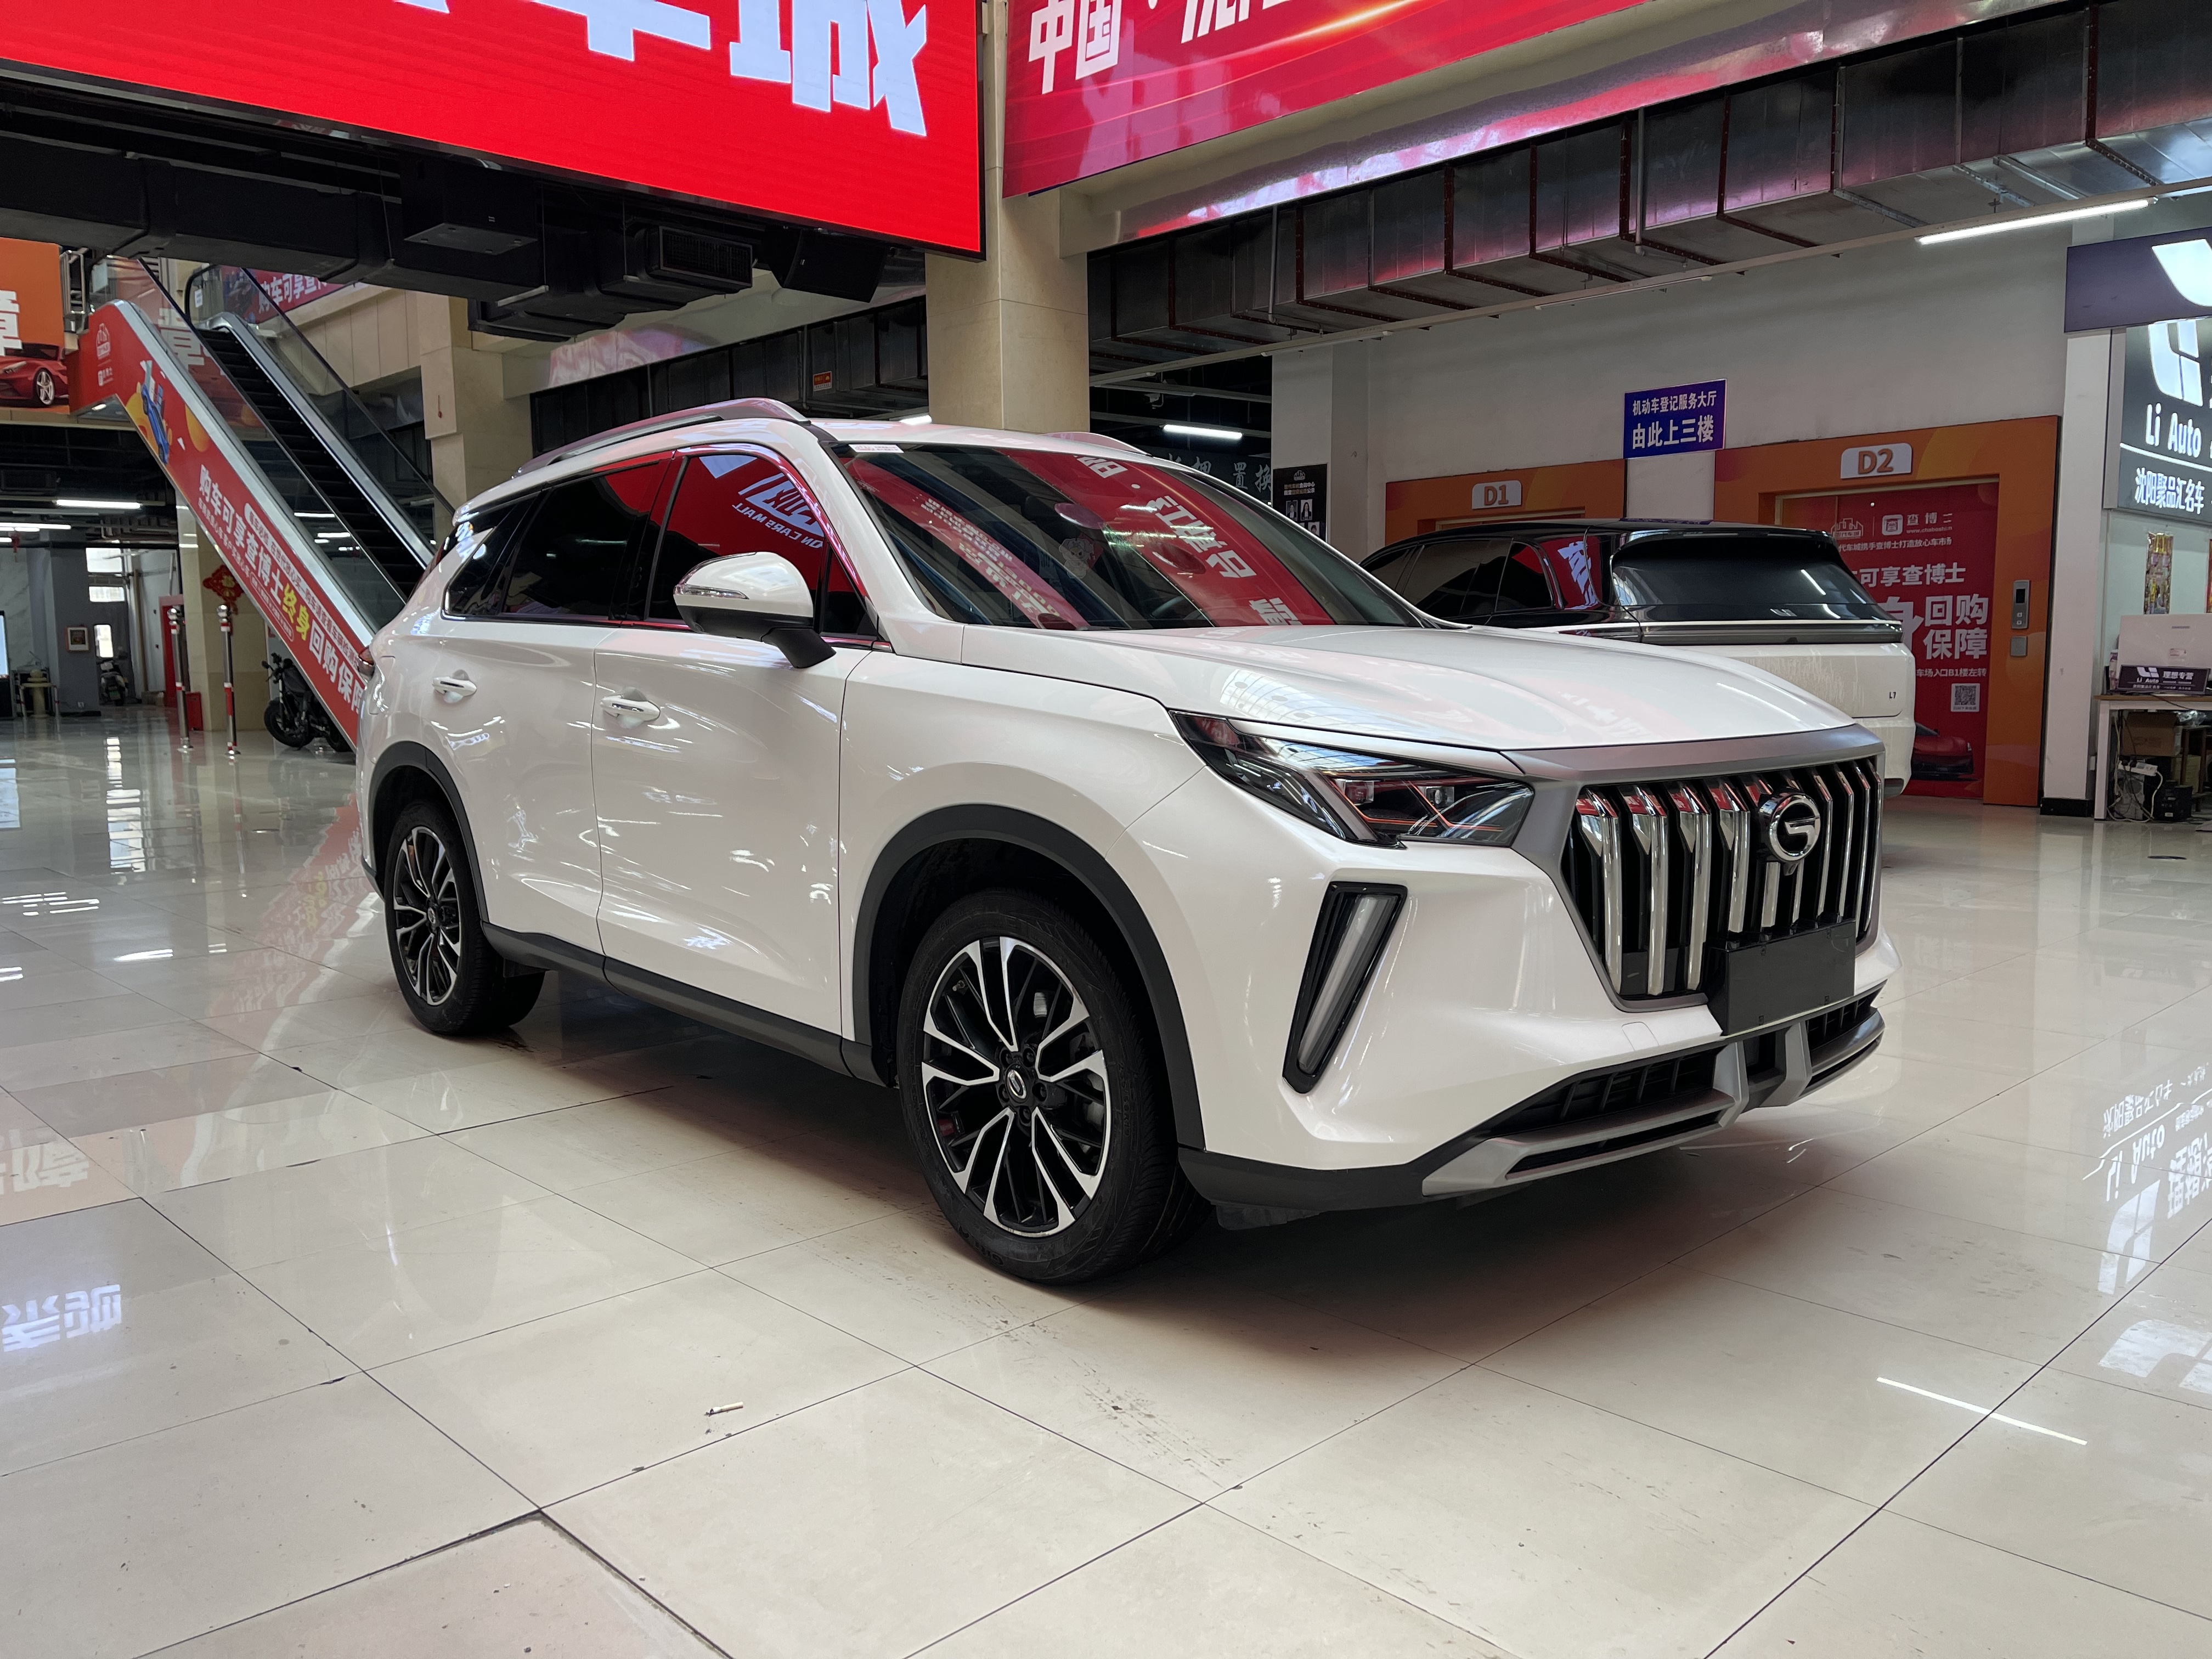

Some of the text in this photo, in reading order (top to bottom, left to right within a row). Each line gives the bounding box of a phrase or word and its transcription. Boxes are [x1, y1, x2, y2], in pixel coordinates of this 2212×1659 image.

[258, 273, 328, 314] 购车可享查
[1632, 391, 1717, 416] 机动车登记服务大厅
[1632, 414, 1714, 449] 由此上三楼
[2145, 402, 2202, 459] Li Auto
[1858, 448, 1894, 475] D2
[1484, 484, 1509, 506] D1
[2134, 467, 2205, 515] 沈阳聚品汇名车
[1852, 562, 1966, 588] 可享查博士
[1925, 594, 1989, 627] 回购
[1923, 627, 1988, 660] 保障
[1916, 667, 1987, 678] 车场入口B1楼左转
